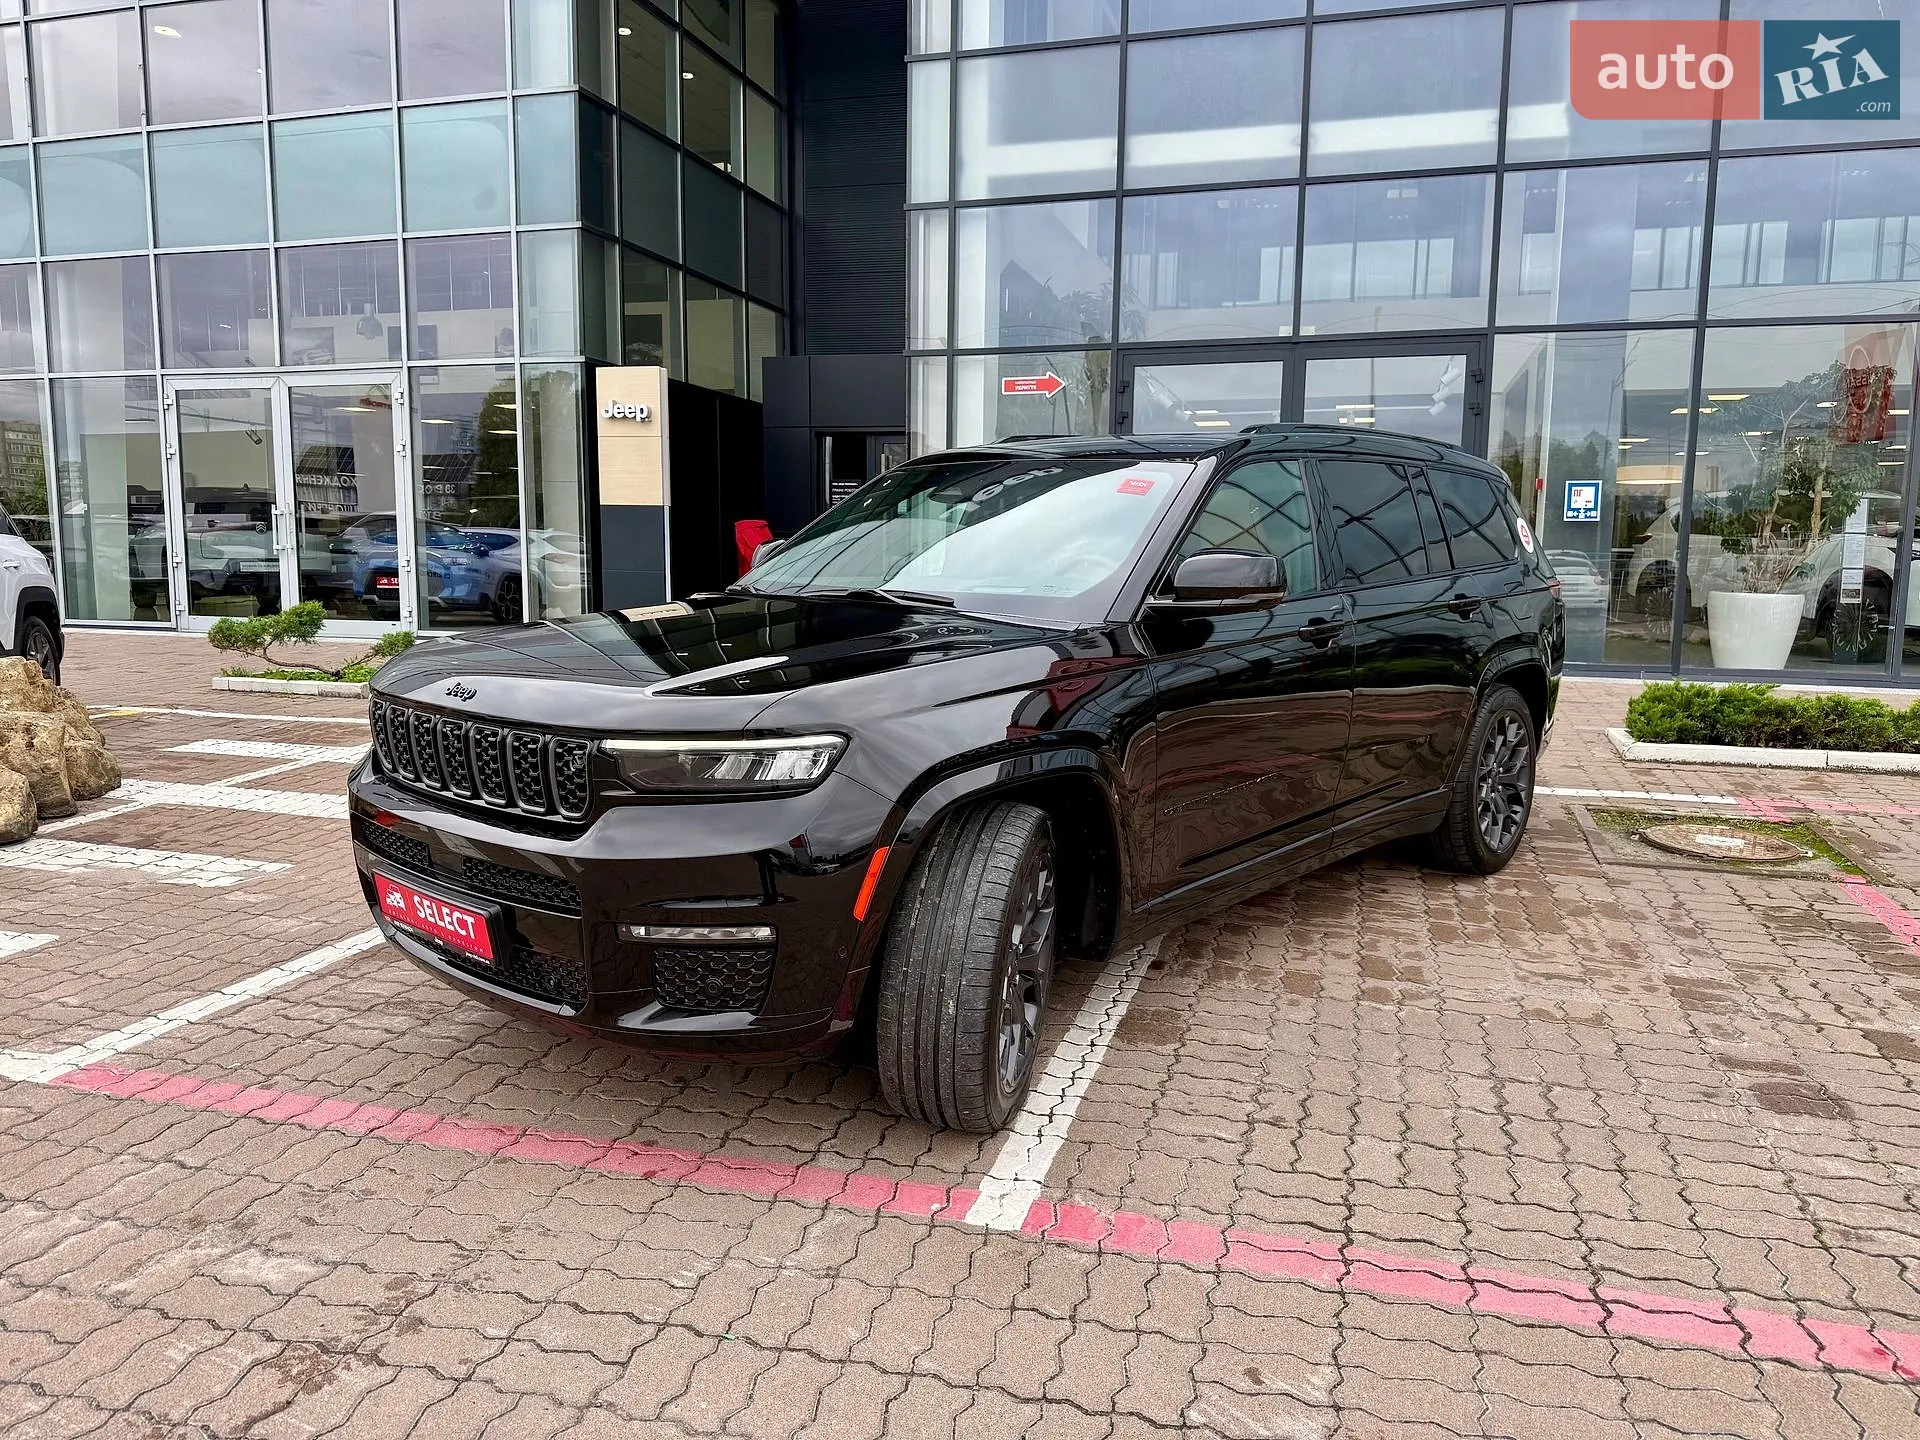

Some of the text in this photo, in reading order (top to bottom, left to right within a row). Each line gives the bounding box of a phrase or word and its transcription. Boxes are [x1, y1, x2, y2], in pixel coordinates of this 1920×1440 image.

[600, 399, 648, 422] Jeep
[445, 681, 477, 702] Jeep
[413, 895, 475, 940] SELECT
